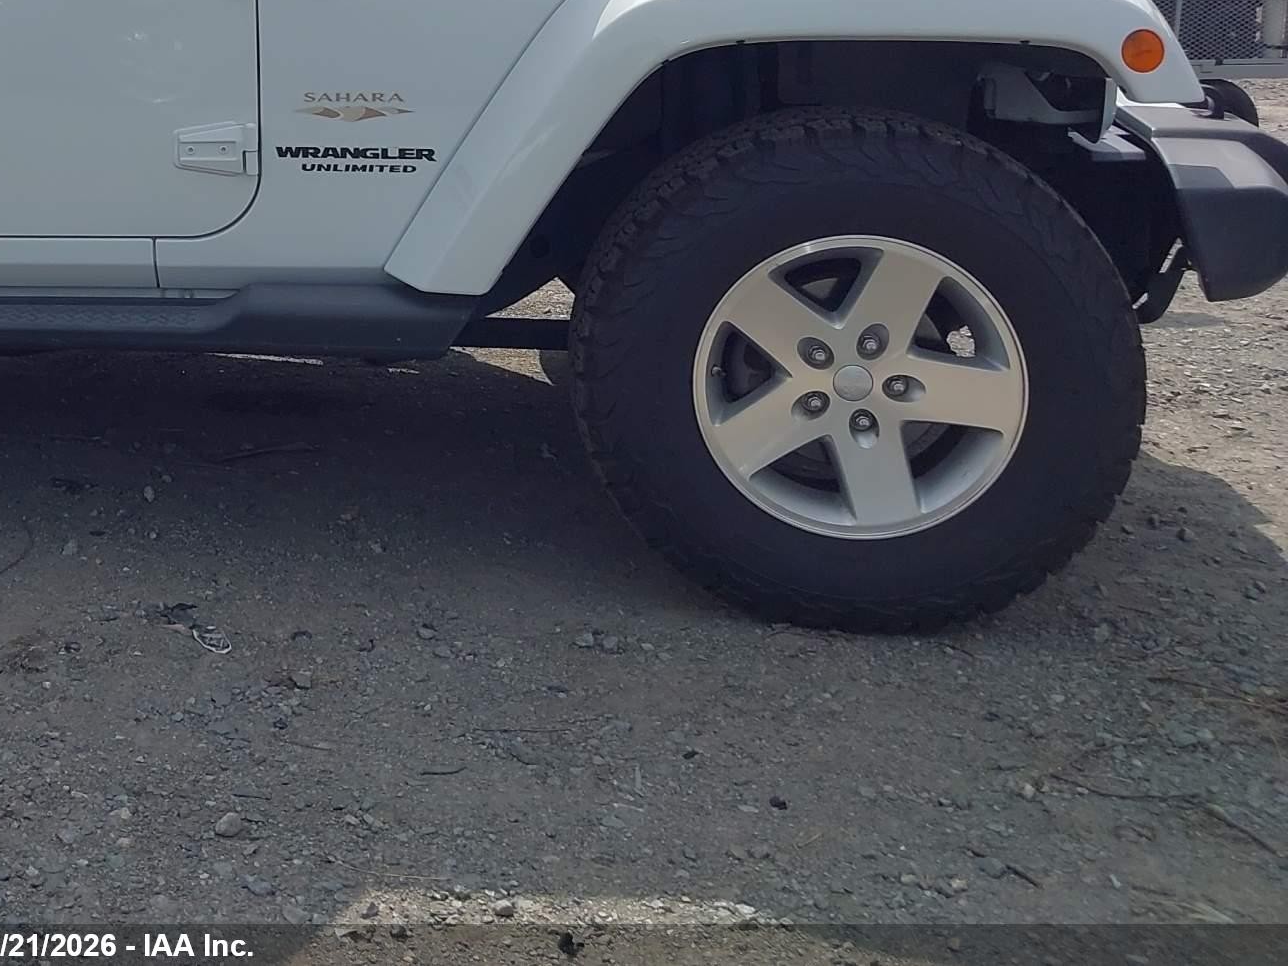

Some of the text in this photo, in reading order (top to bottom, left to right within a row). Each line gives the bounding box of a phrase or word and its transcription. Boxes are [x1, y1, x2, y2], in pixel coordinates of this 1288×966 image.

[304, 92, 404, 103] SAHARA
[275, 146, 438, 162] WRANGLER
[301, 163, 418, 174] UNLIMITED
